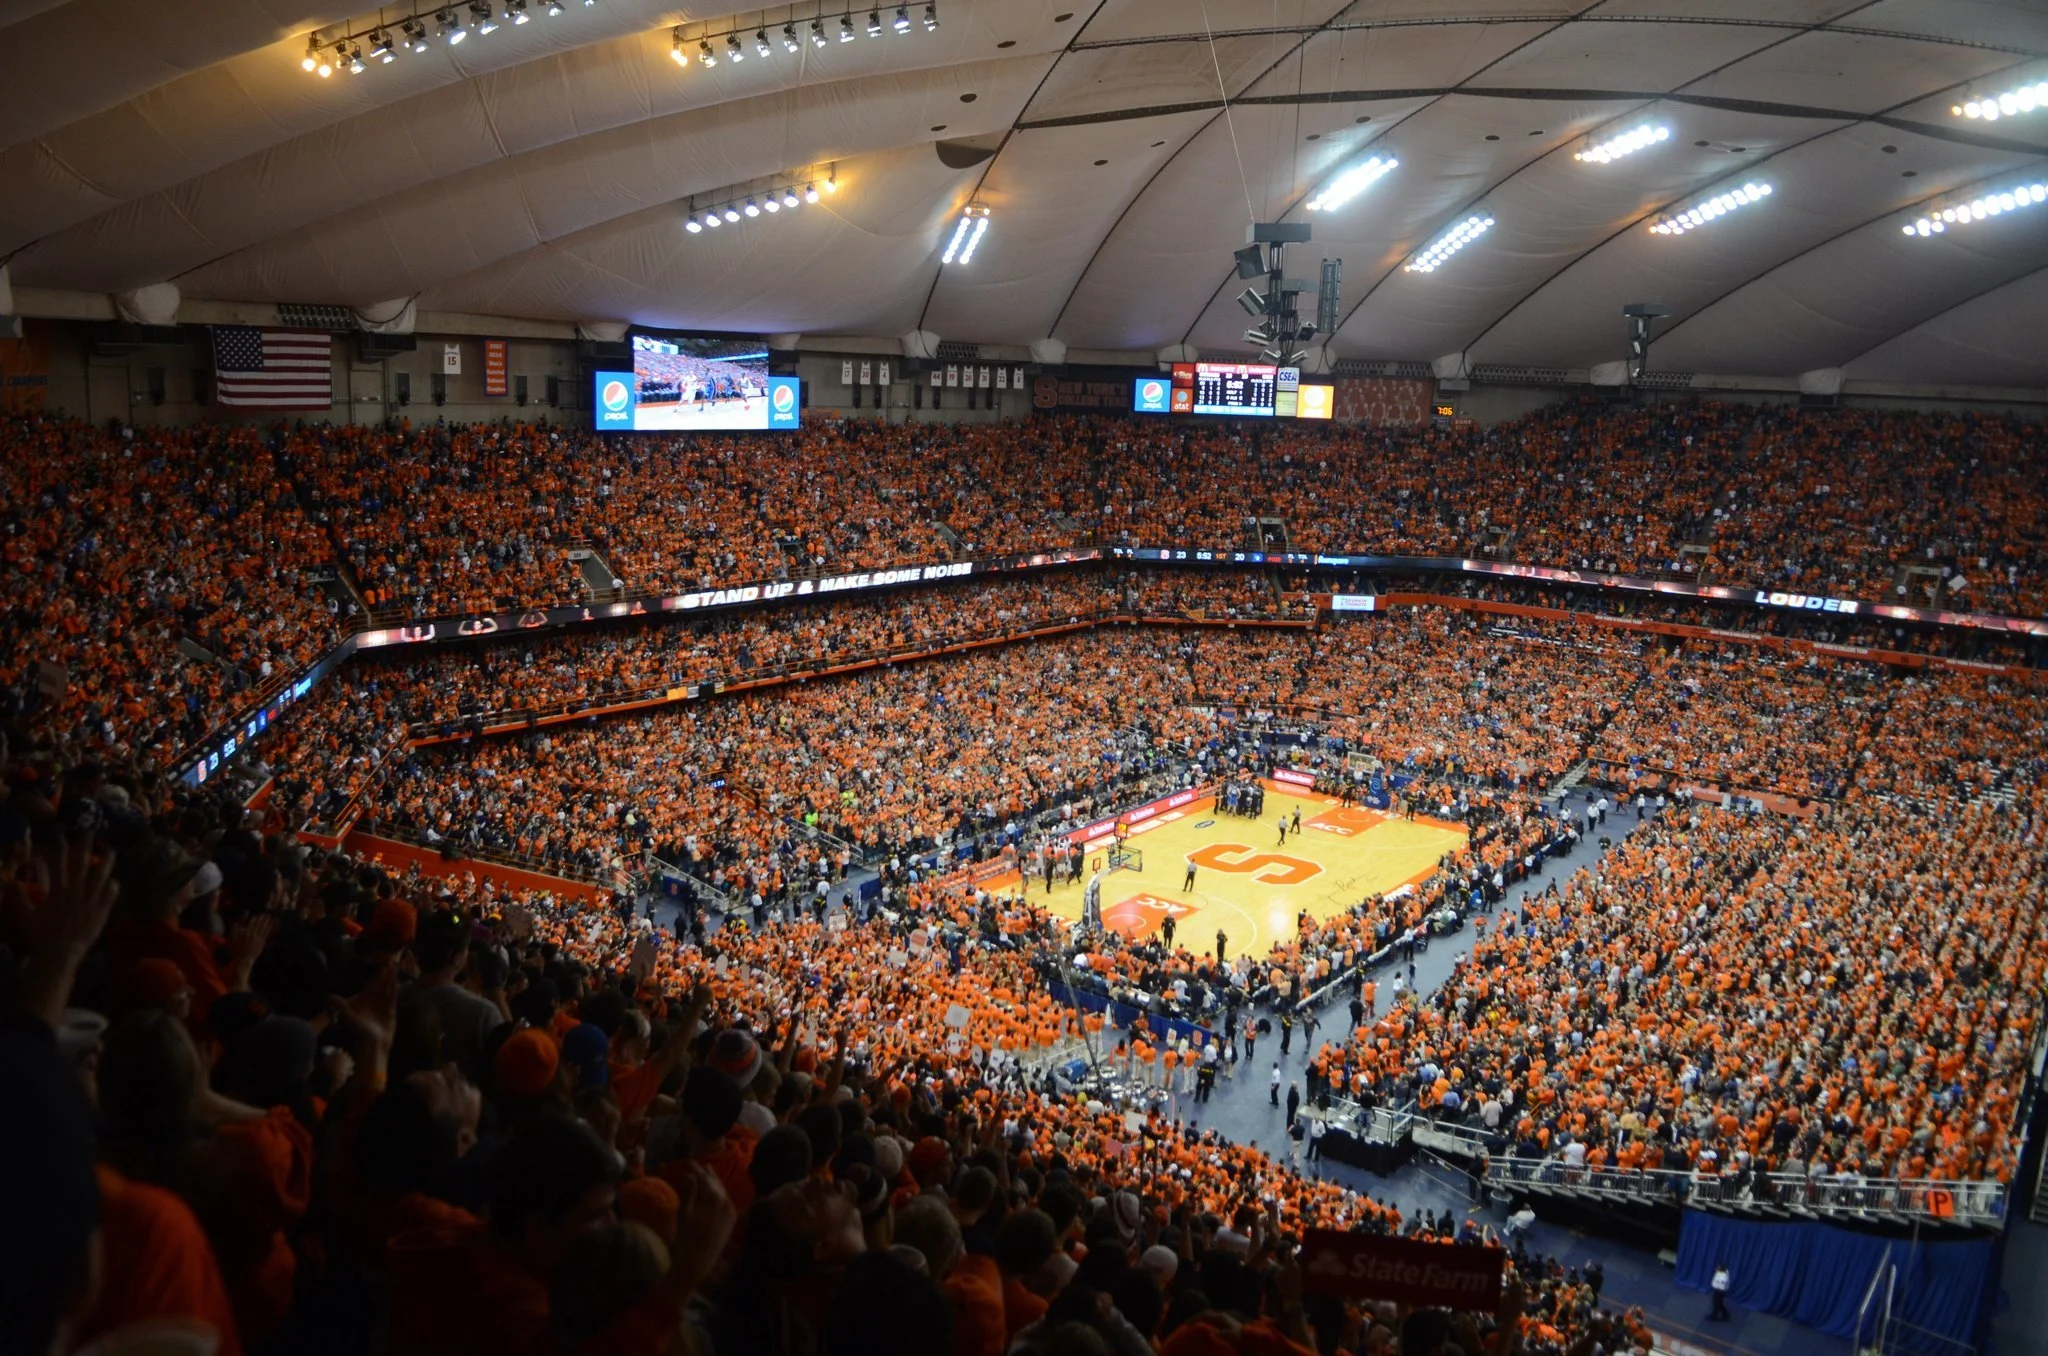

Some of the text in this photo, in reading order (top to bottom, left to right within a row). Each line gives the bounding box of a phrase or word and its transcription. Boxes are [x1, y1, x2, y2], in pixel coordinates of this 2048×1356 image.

[447, 356, 457, 366] 15
[861, 371, 870, 379] 30
[882, 371, 887, 379] 4
[1437, 406, 1454, 416] 7:06
[1176, 551, 1187, 560] 23
[1195, 552, 1213, 561] 5:52
[1234, 553, 1246, 561] 20
[678, 562, 973, 609] STAND UP & MAKE SOME NOISE
[1755, 591, 1859, 613] LOUDER
[1310, 822, 1353, 835] ACC
[1136, 897, 1189, 913] ACC
[1933, 1190, 1948, 1217] P
[1349, 1252, 1489, 1293] StateFarm
